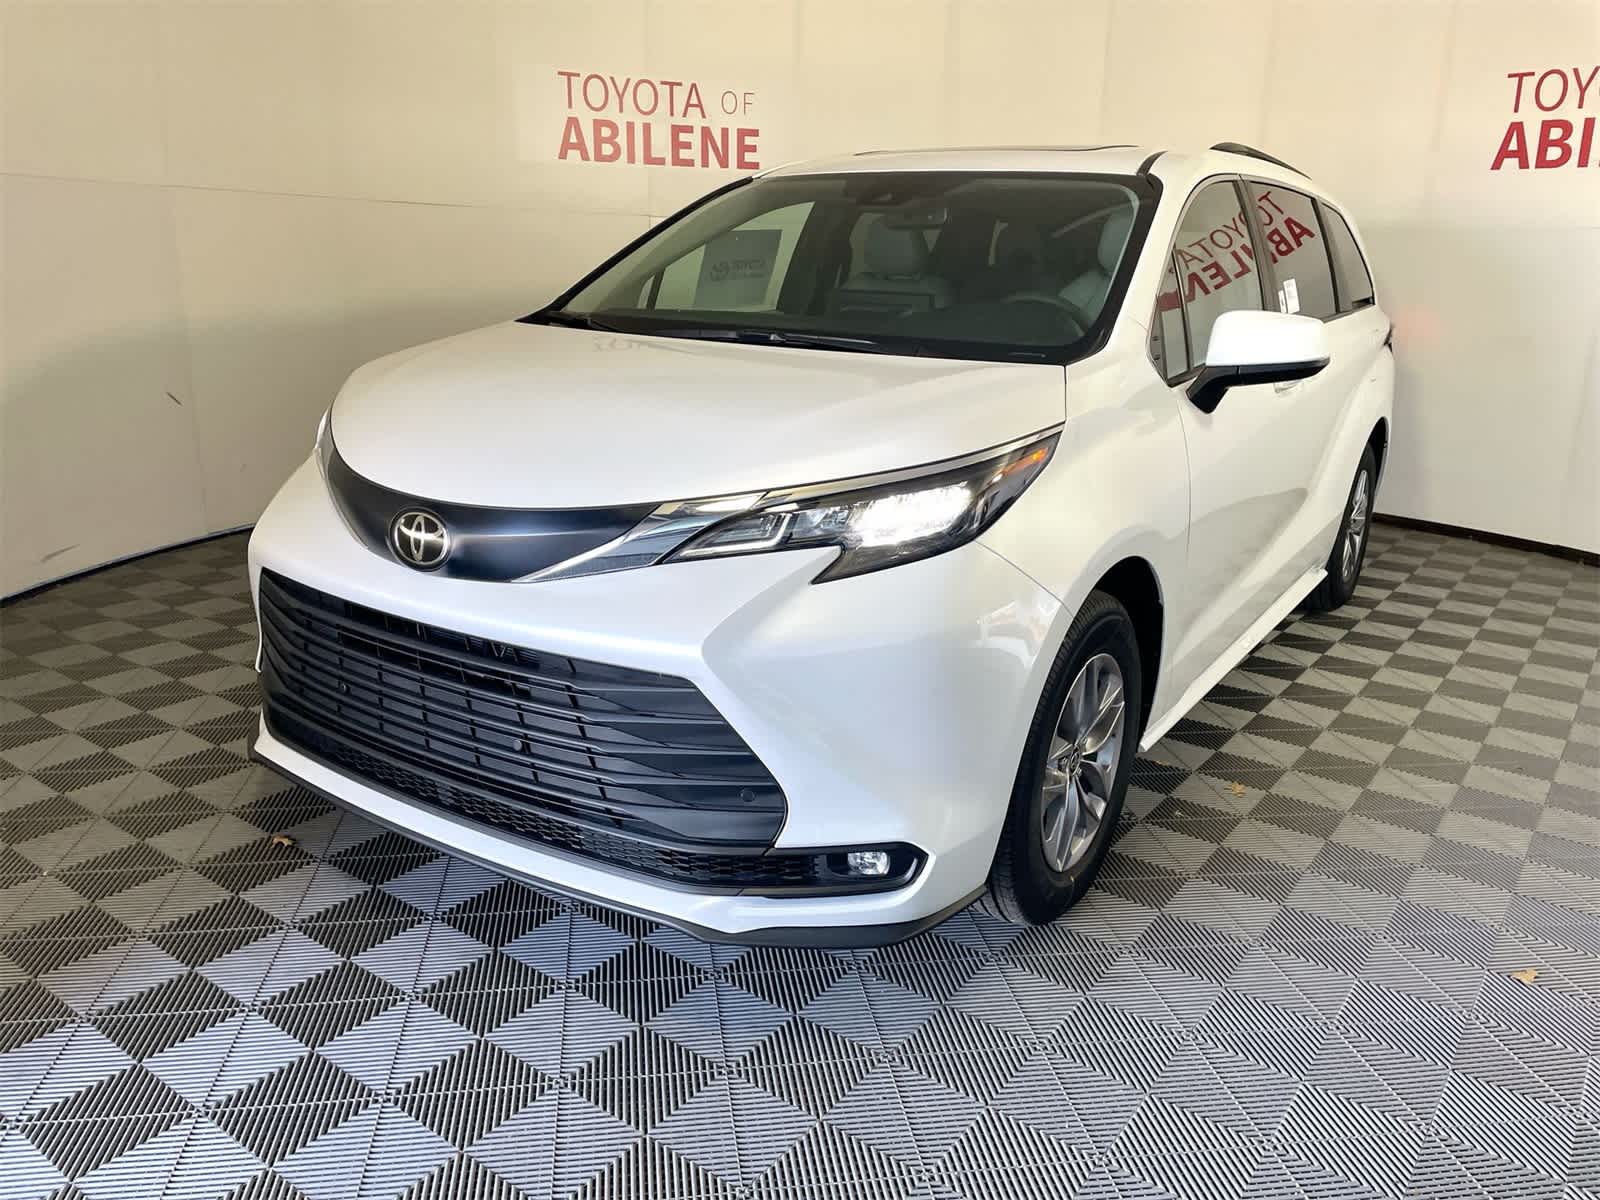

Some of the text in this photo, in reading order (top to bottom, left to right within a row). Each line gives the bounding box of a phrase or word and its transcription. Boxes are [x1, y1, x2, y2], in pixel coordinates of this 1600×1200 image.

[557, 71, 755, 119] TOYOTA OF
[1507, 66, 1600, 113] TOY
[558, 116, 760, 170] ABILENE
[1490, 117, 1600, 170] ABI
